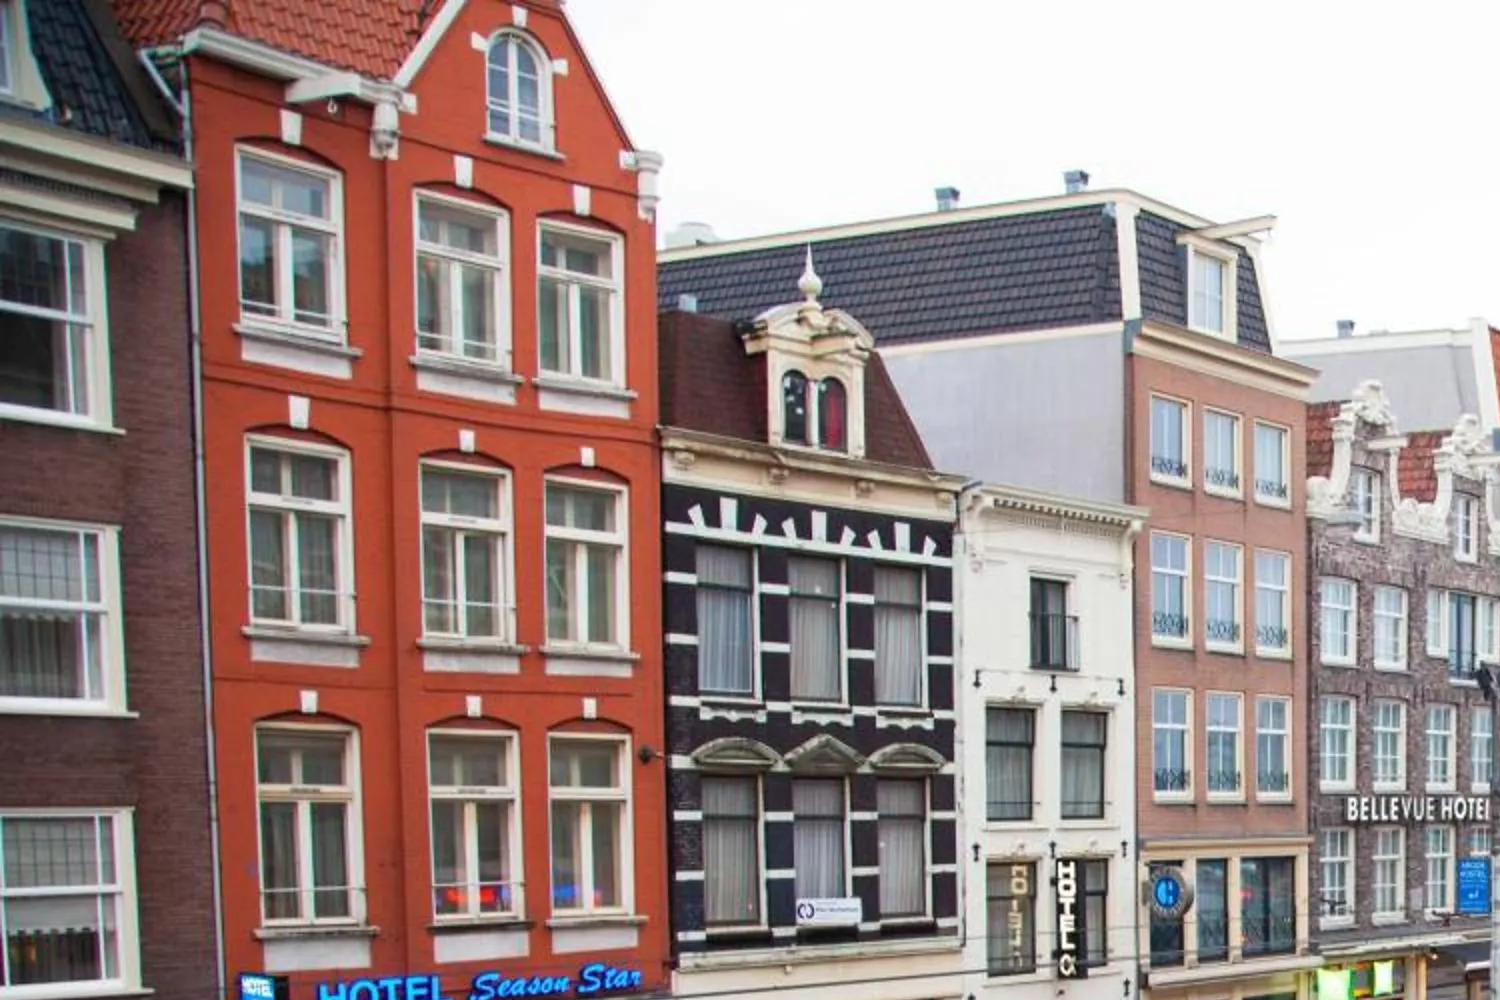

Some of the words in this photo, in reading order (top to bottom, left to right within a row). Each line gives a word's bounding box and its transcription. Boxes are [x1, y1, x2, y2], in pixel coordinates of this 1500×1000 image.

[1347, 796, 1435, 821] BELLEVUE
[1057, 860, 1077, 950] HOTEL
[241, 975, 274, 998] HOTEL
[577, 962, 642, 993] Star
